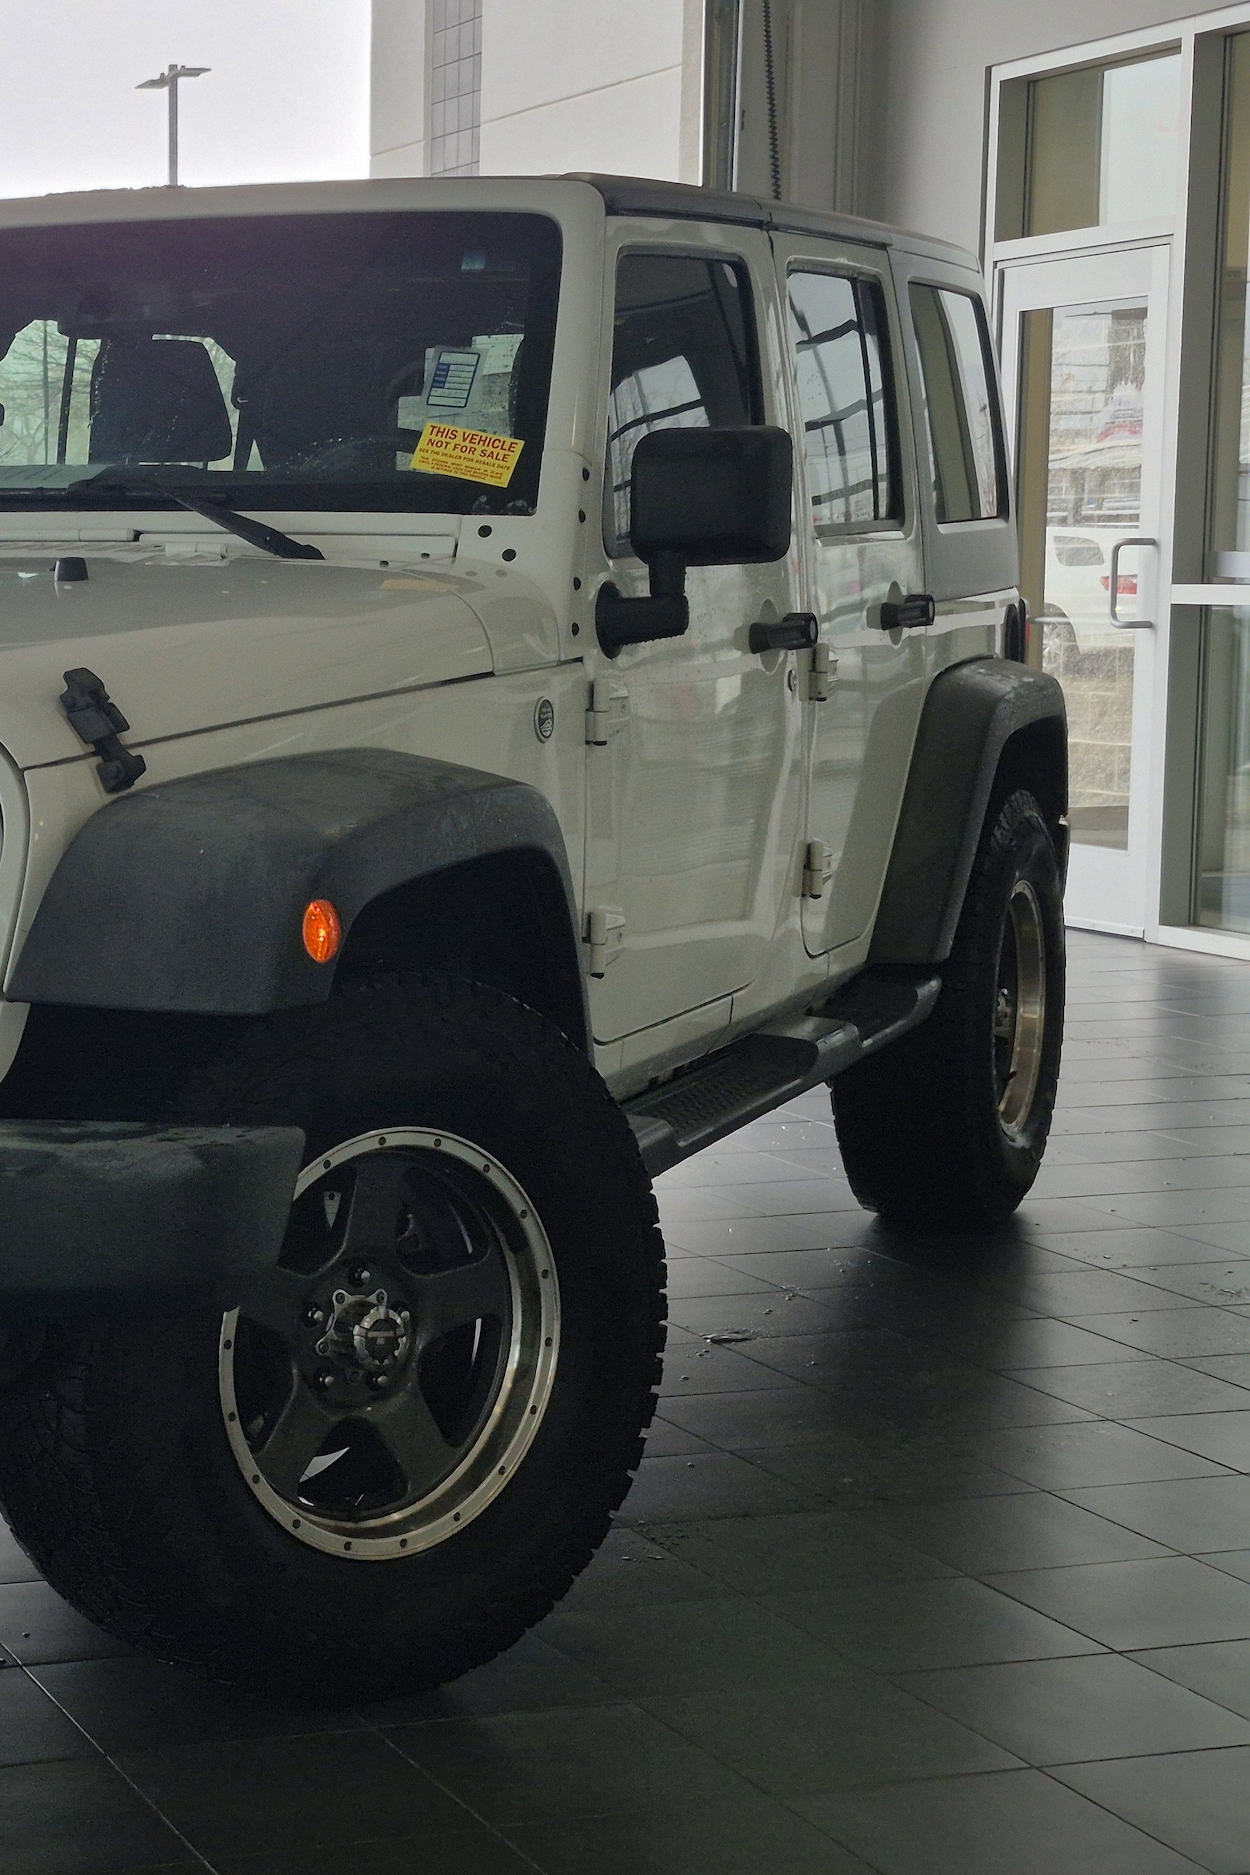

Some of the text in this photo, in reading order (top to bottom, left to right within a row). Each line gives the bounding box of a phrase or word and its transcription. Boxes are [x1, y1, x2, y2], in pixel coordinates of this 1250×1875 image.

[426, 438, 511, 463] NOT FOR SALE
[429, 425, 518, 453] THIS VEHICLE
[441, 452, 462, 461] DEALER
[496, 463, 511, 471] DATE
